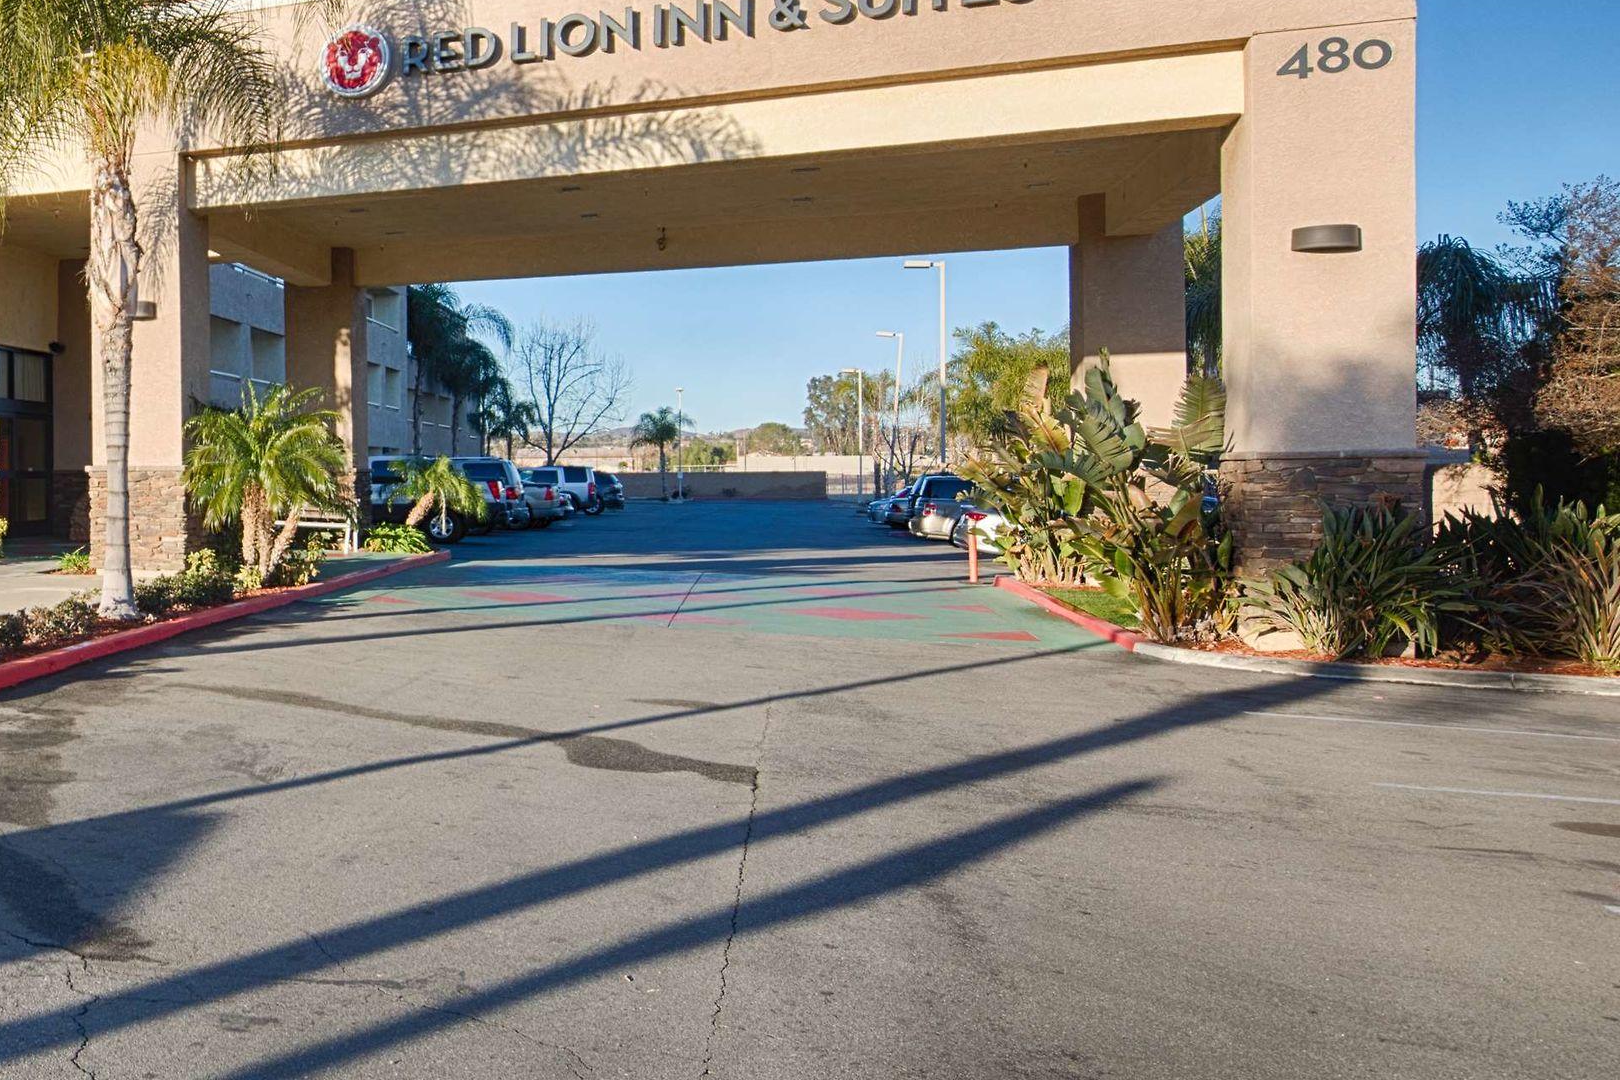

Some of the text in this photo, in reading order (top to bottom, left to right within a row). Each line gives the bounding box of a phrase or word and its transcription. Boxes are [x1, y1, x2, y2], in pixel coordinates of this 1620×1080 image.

[402, 27, 503, 76] RED
[511, 6, 641, 64] LION
[1276, 37, 1393, 79] 480
